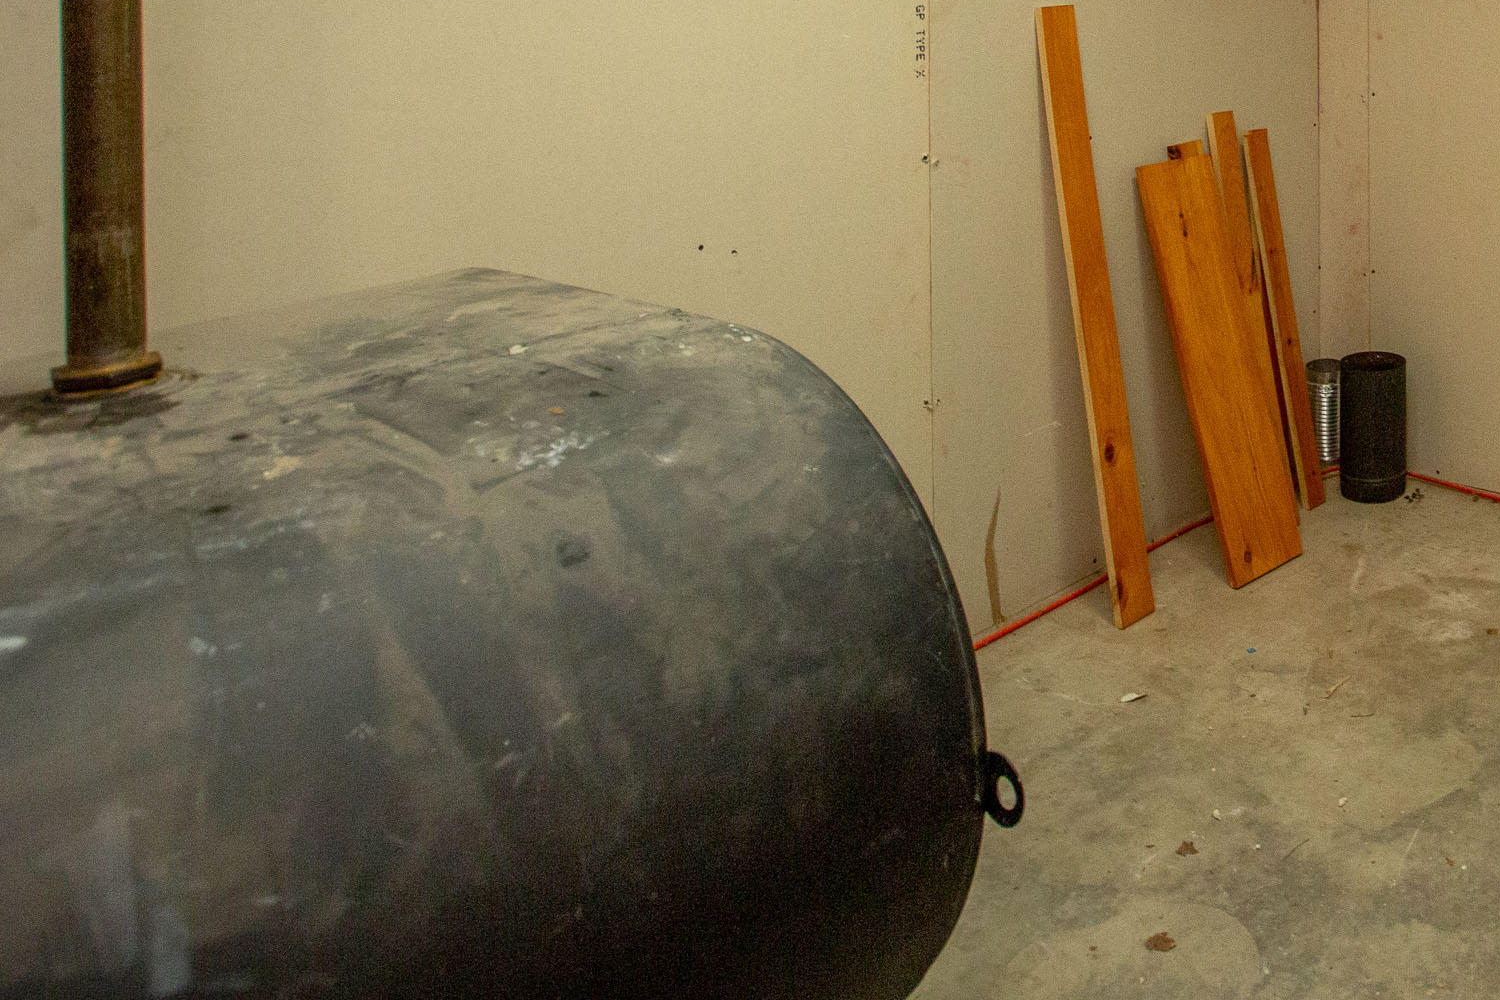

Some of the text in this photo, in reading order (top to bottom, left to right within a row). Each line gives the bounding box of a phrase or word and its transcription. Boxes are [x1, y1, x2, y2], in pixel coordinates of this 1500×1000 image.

[915, 5, 925, 20] GP
[915, 29, 926, 61] TYPE
[916, 70, 926, 78] X
